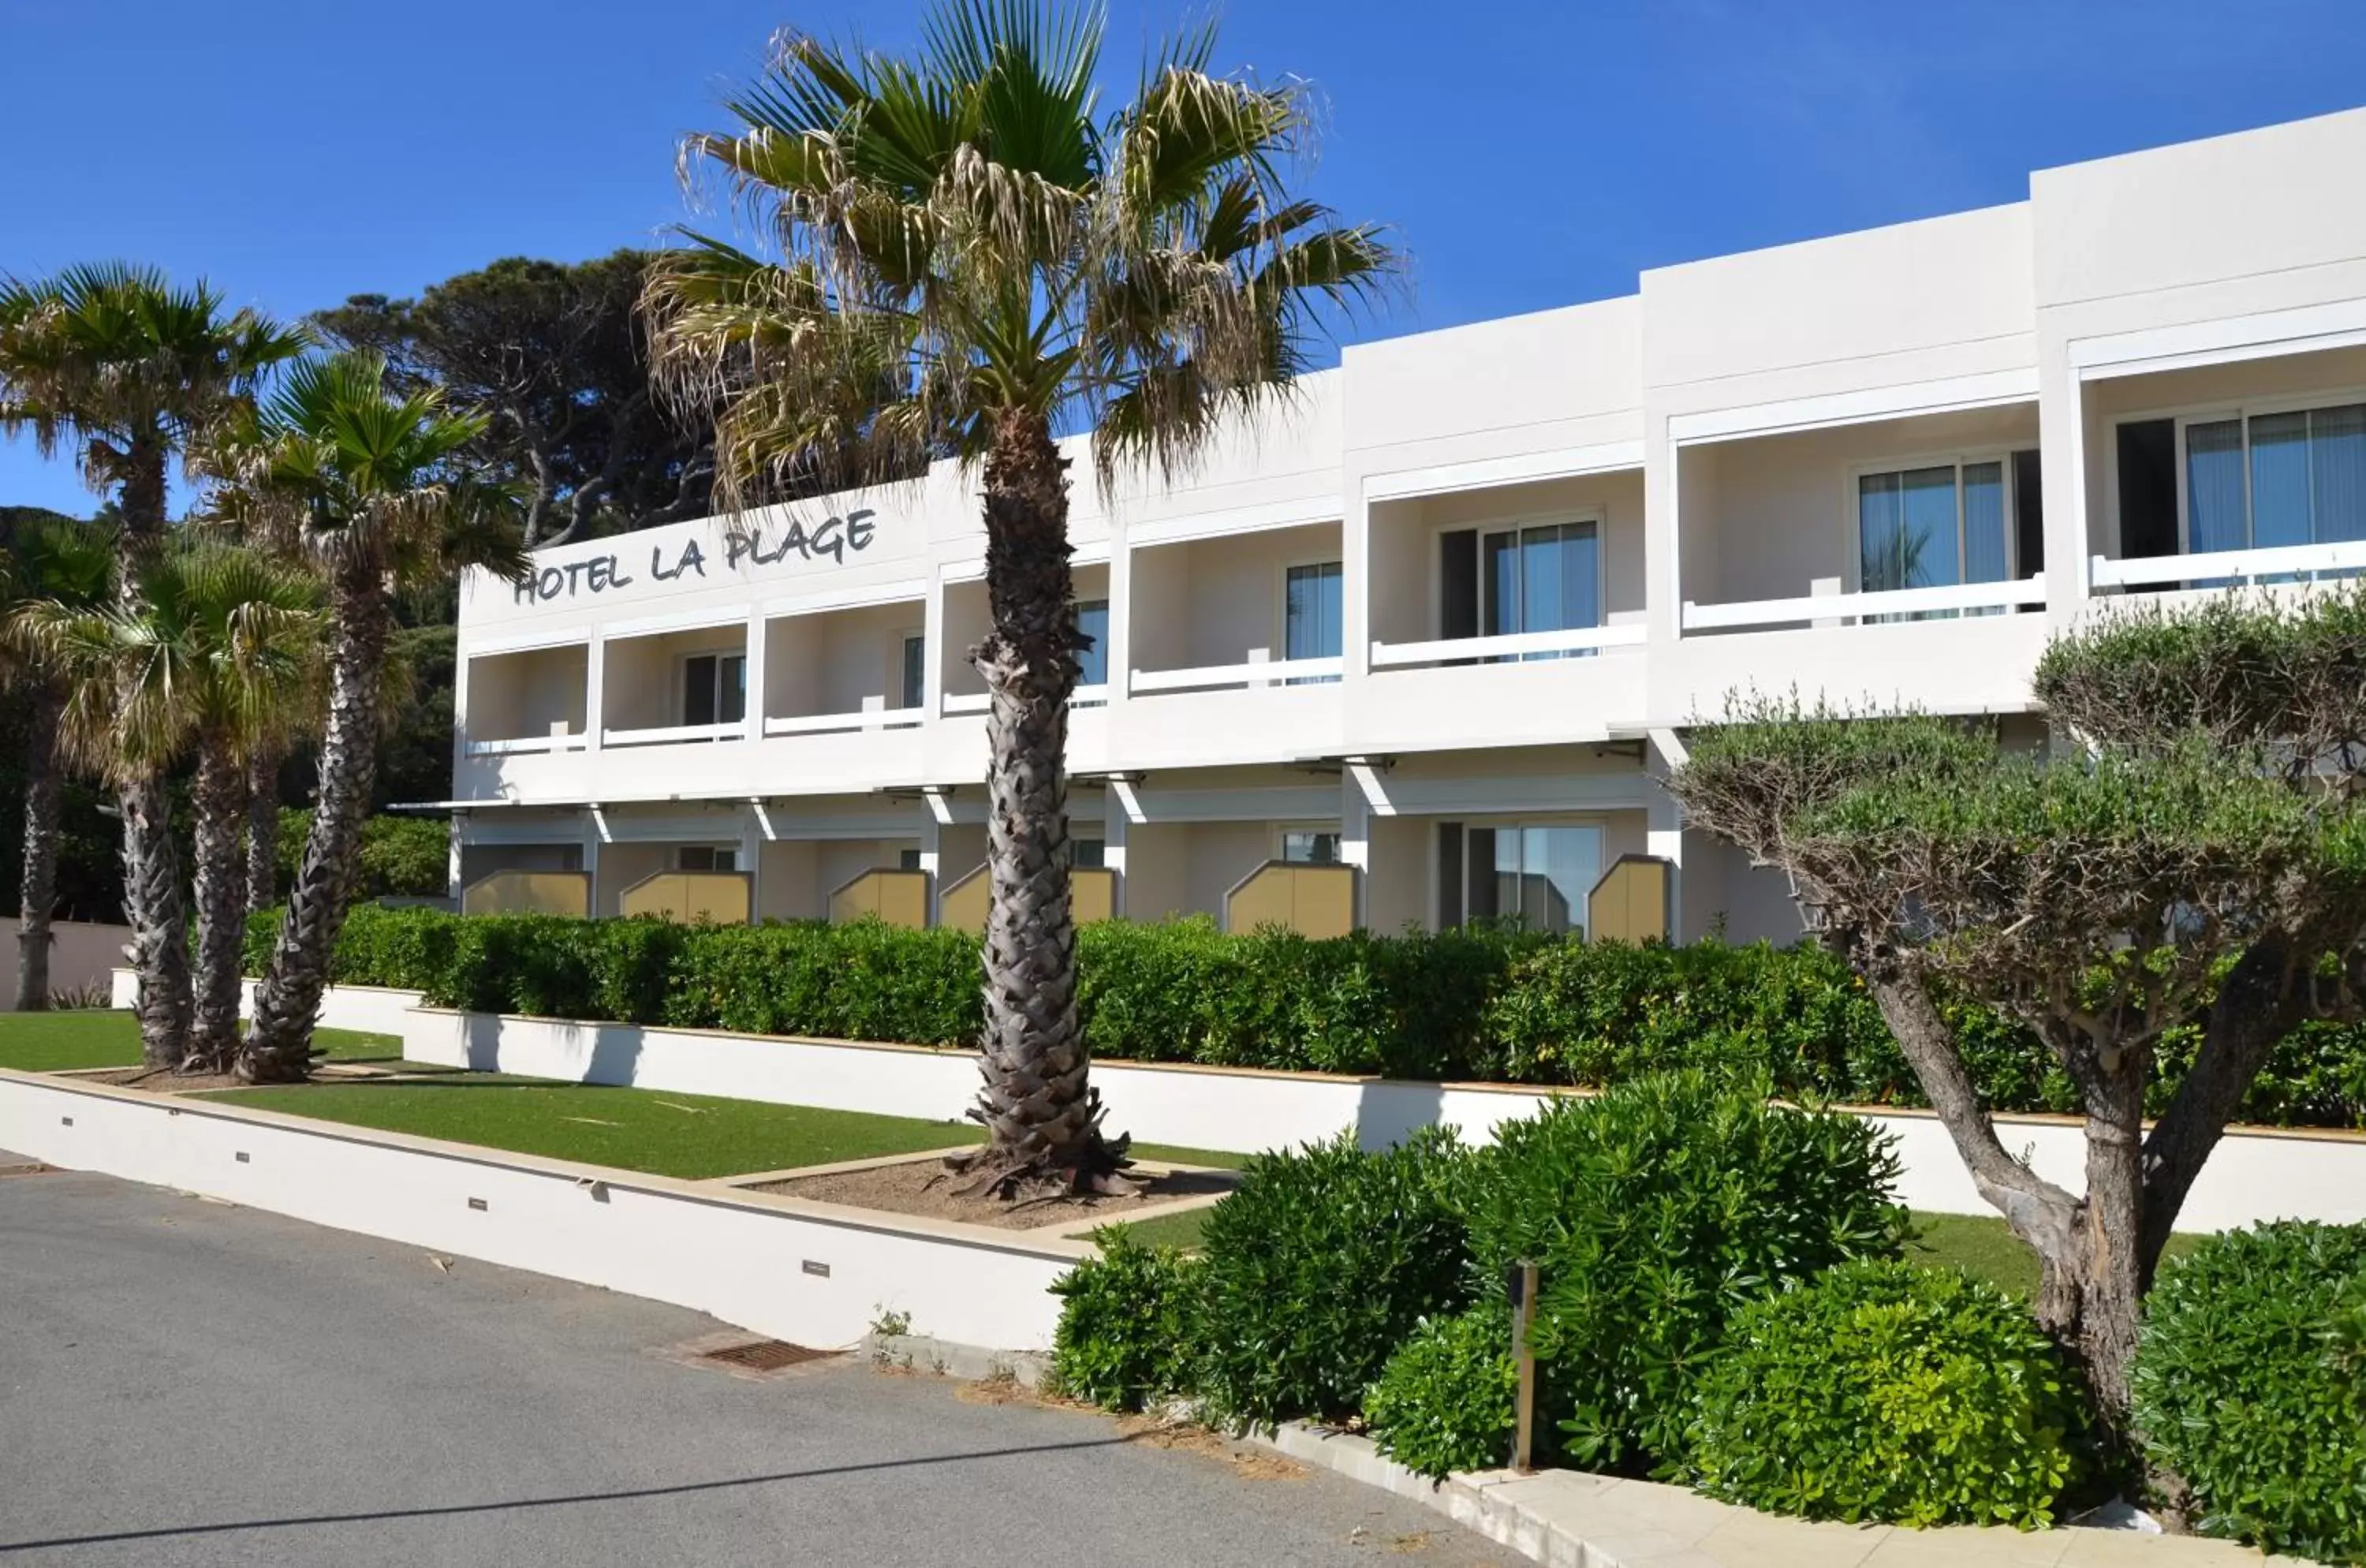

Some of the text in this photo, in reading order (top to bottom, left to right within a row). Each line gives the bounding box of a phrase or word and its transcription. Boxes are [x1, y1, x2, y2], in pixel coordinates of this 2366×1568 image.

[514, 510, 876, 606] HOTEL LA PLAGE
